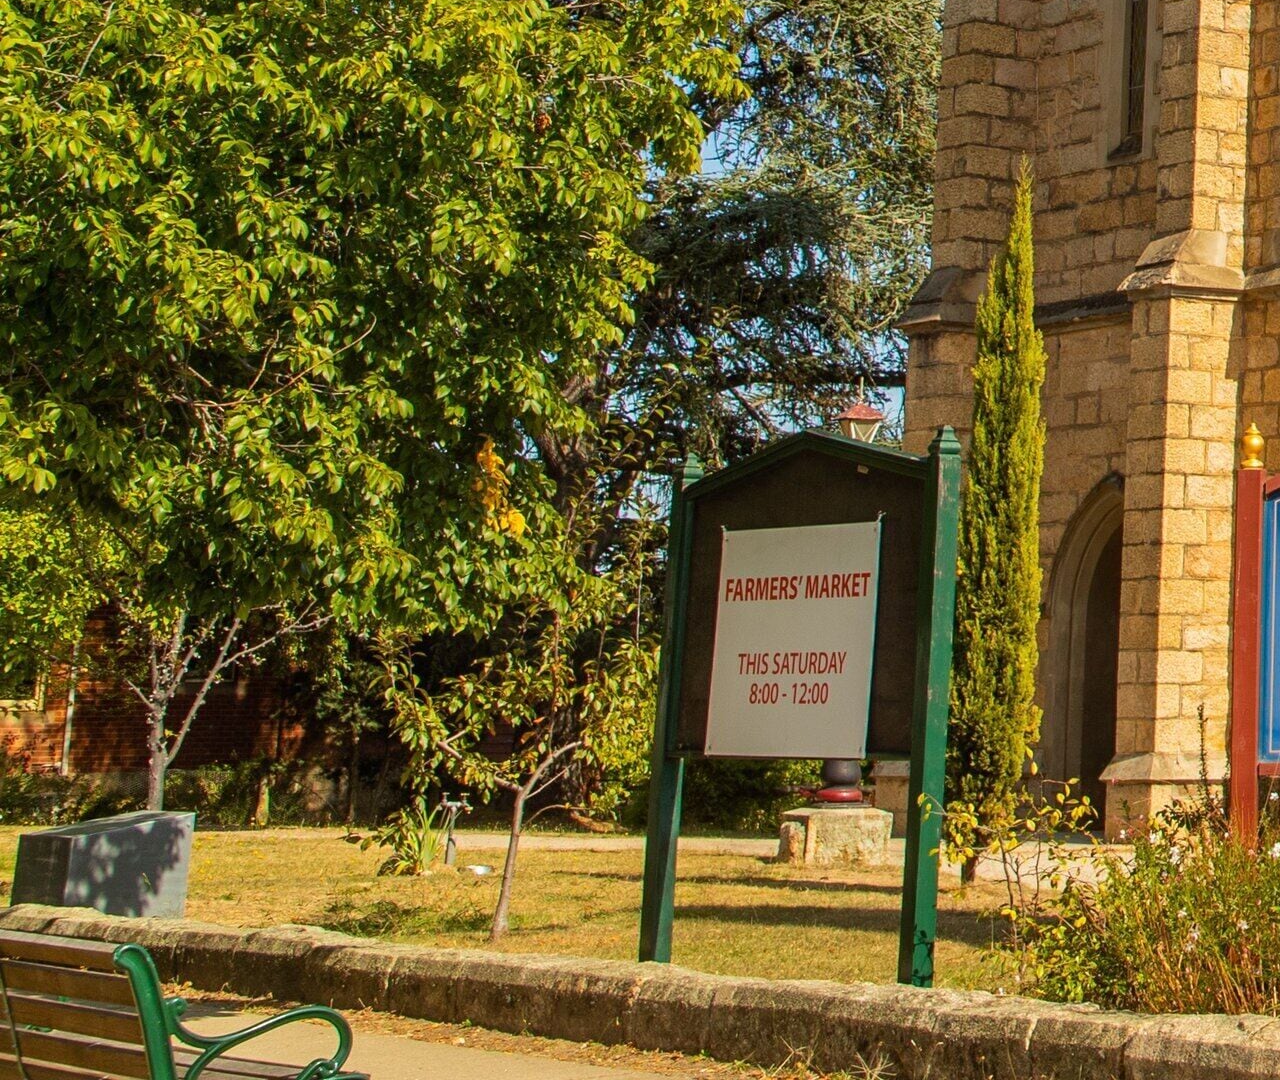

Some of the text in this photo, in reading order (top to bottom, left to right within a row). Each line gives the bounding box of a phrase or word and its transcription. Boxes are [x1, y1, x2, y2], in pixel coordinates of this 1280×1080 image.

[805, 573, 871, 599] MARKET
[738, 651, 847, 675] THIS SATURDAY
[749, 683, 779, 704] 8:00
[792, 682, 829, 705] 12:00
